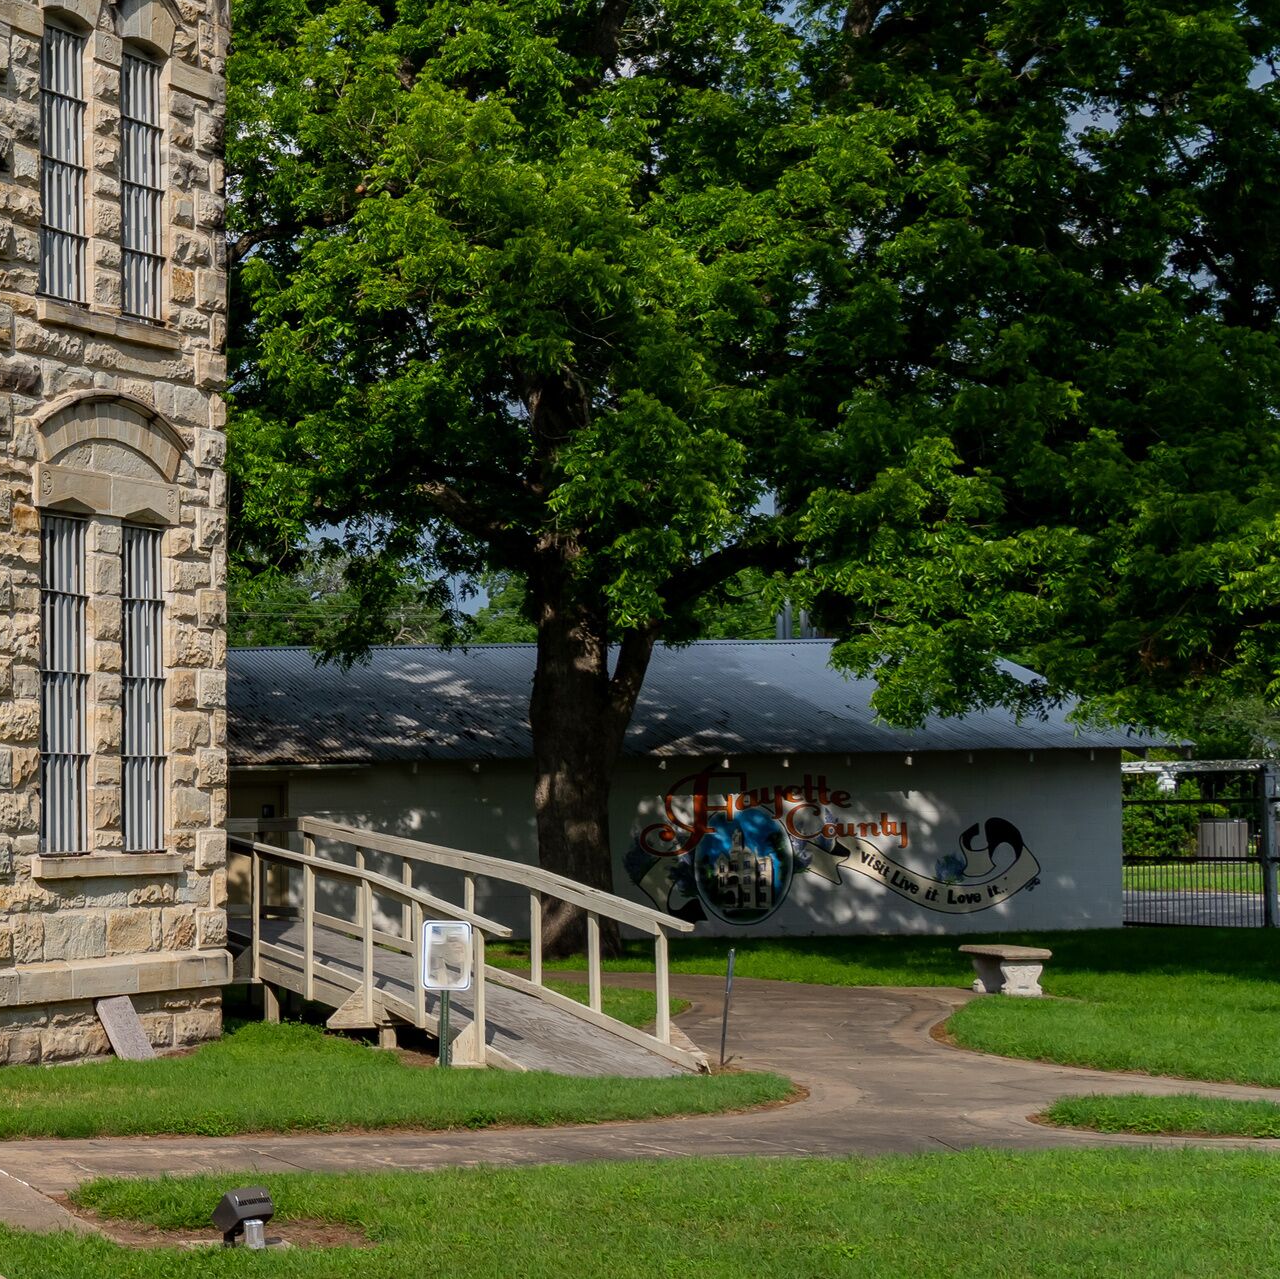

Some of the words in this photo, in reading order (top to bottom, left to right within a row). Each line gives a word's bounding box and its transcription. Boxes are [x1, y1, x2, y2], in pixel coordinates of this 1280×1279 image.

[640, 763, 851, 857] Fayette
[786, 803, 909, 849] County
[890, 870, 920, 895] Live
[946, 889, 982, 905] Love
